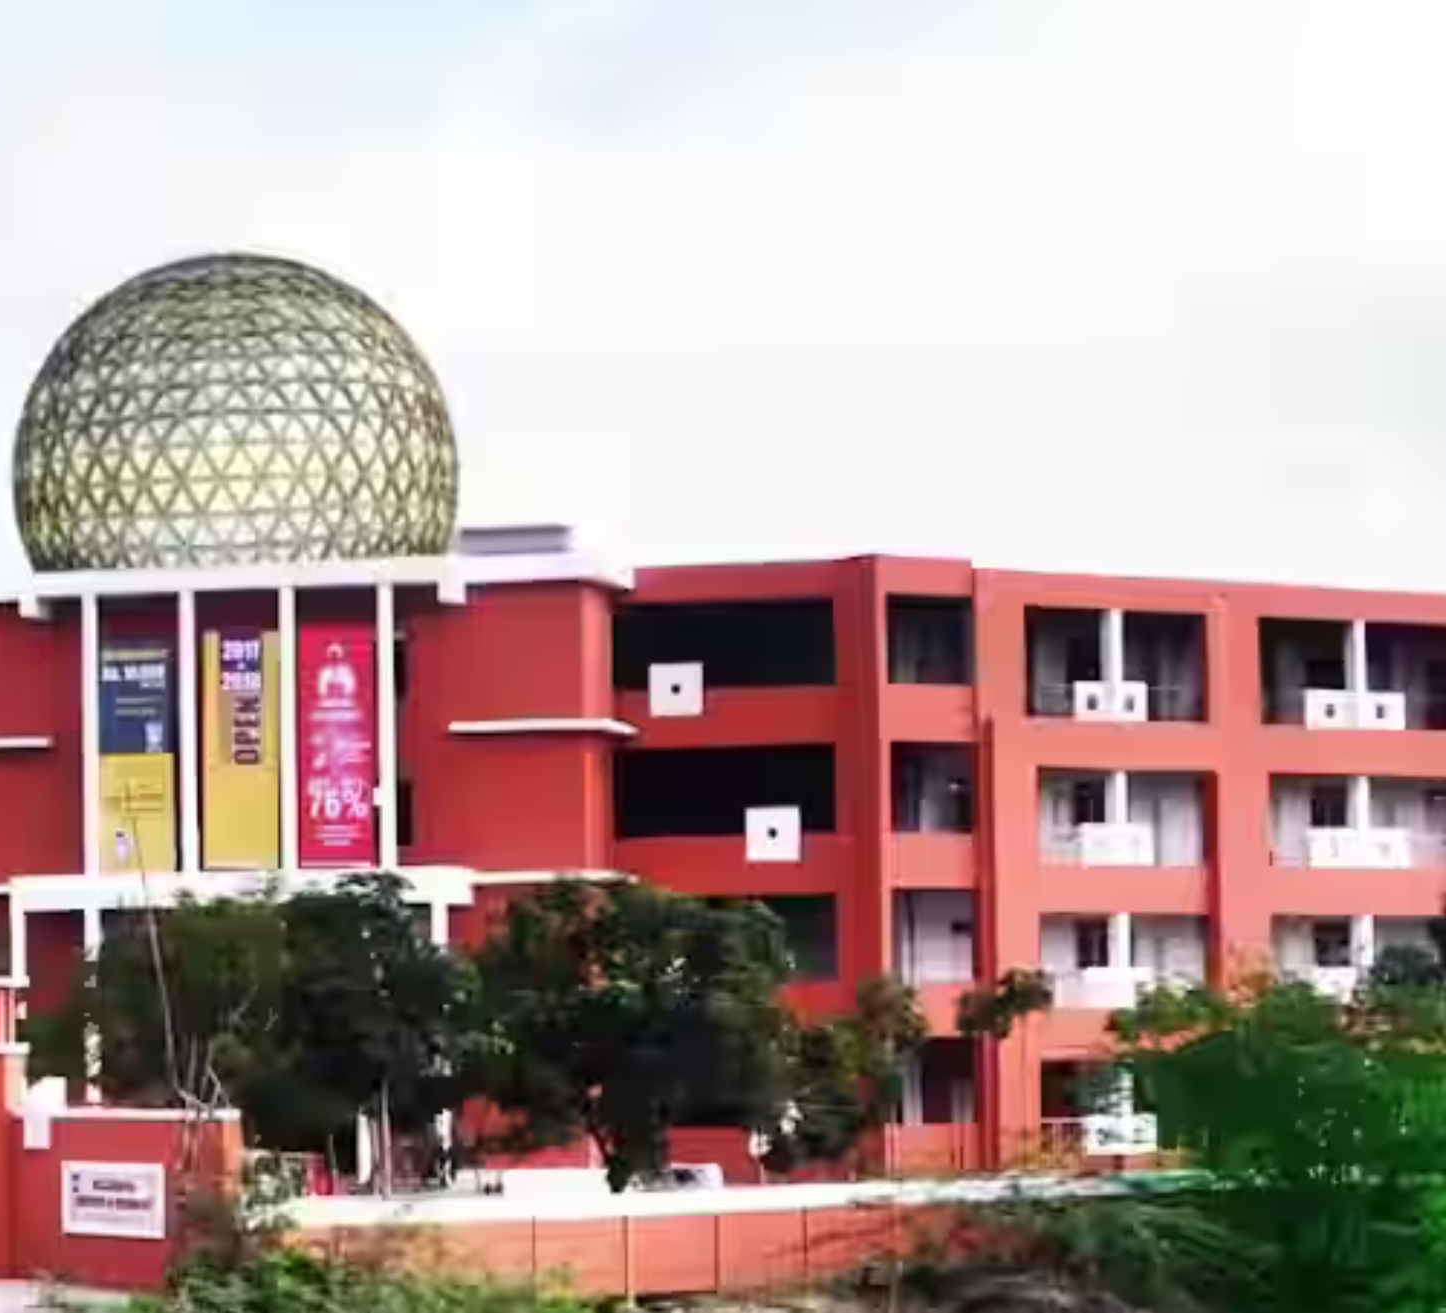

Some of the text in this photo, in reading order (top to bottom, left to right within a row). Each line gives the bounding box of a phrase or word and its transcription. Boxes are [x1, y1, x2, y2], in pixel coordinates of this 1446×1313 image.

[221, 639, 260, 661] 2017
[220, 671, 261, 691] 2018
[233, 695, 261, 765] OPEN
[308, 784, 370, 819] 76%
